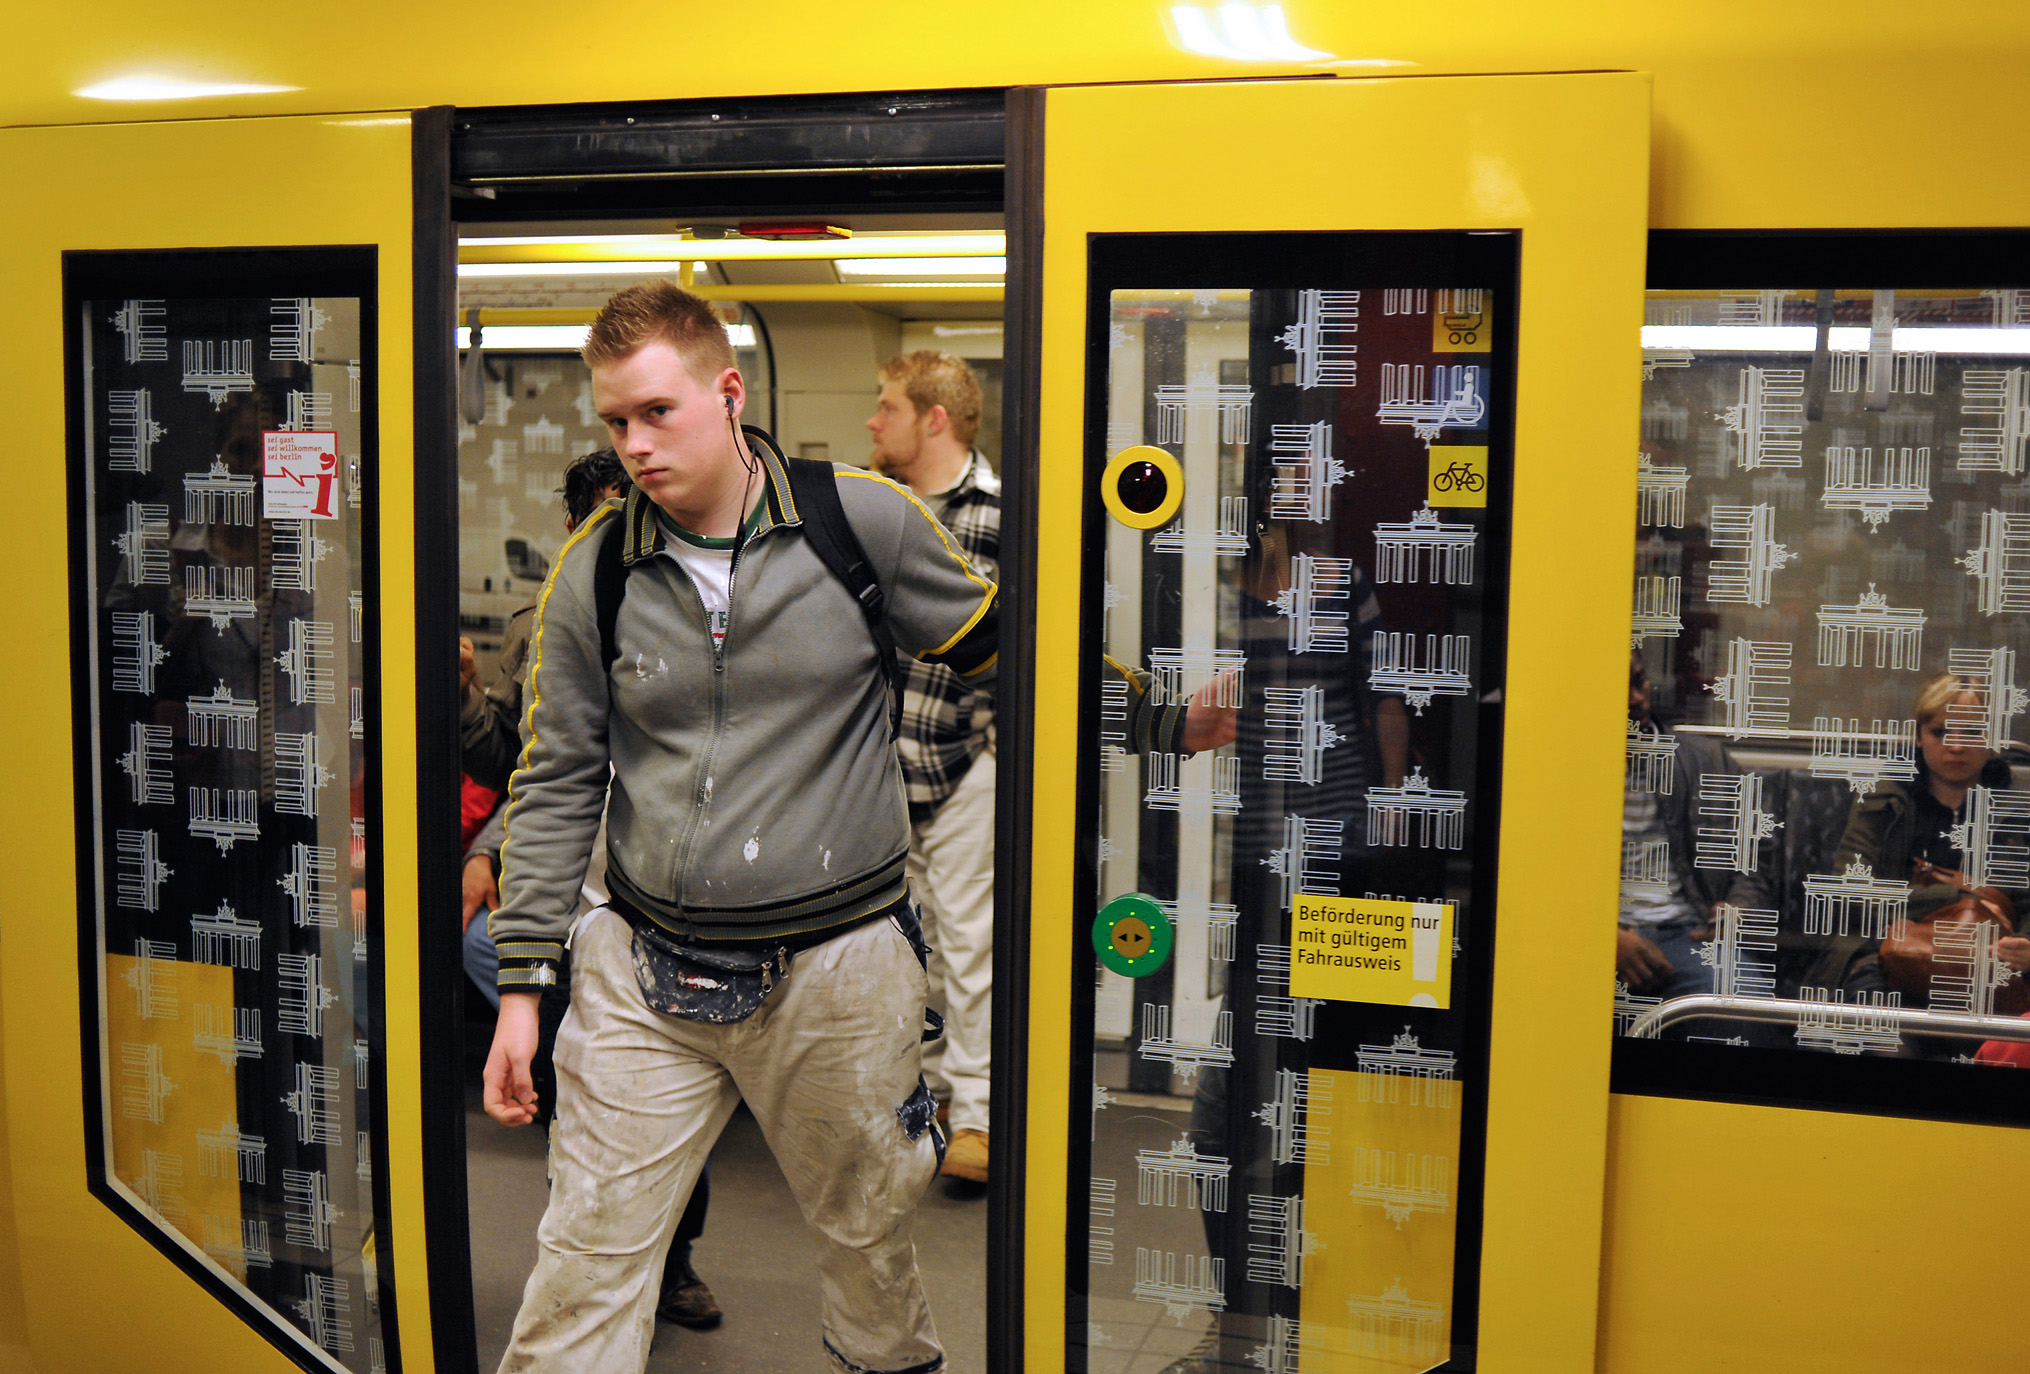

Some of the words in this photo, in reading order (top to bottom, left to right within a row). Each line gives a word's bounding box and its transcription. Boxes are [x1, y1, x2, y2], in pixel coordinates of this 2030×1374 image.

[267, 444, 278, 452] sei
[279, 444, 323, 452] willkommen
[1299, 905, 1405, 932] Beförderung
[1411, 915, 1440, 930] nur
[1298, 928, 1326, 944] mit
[1331, 930, 1407, 952] gültigem
[1298, 949, 1401, 971] Fahrausweis
